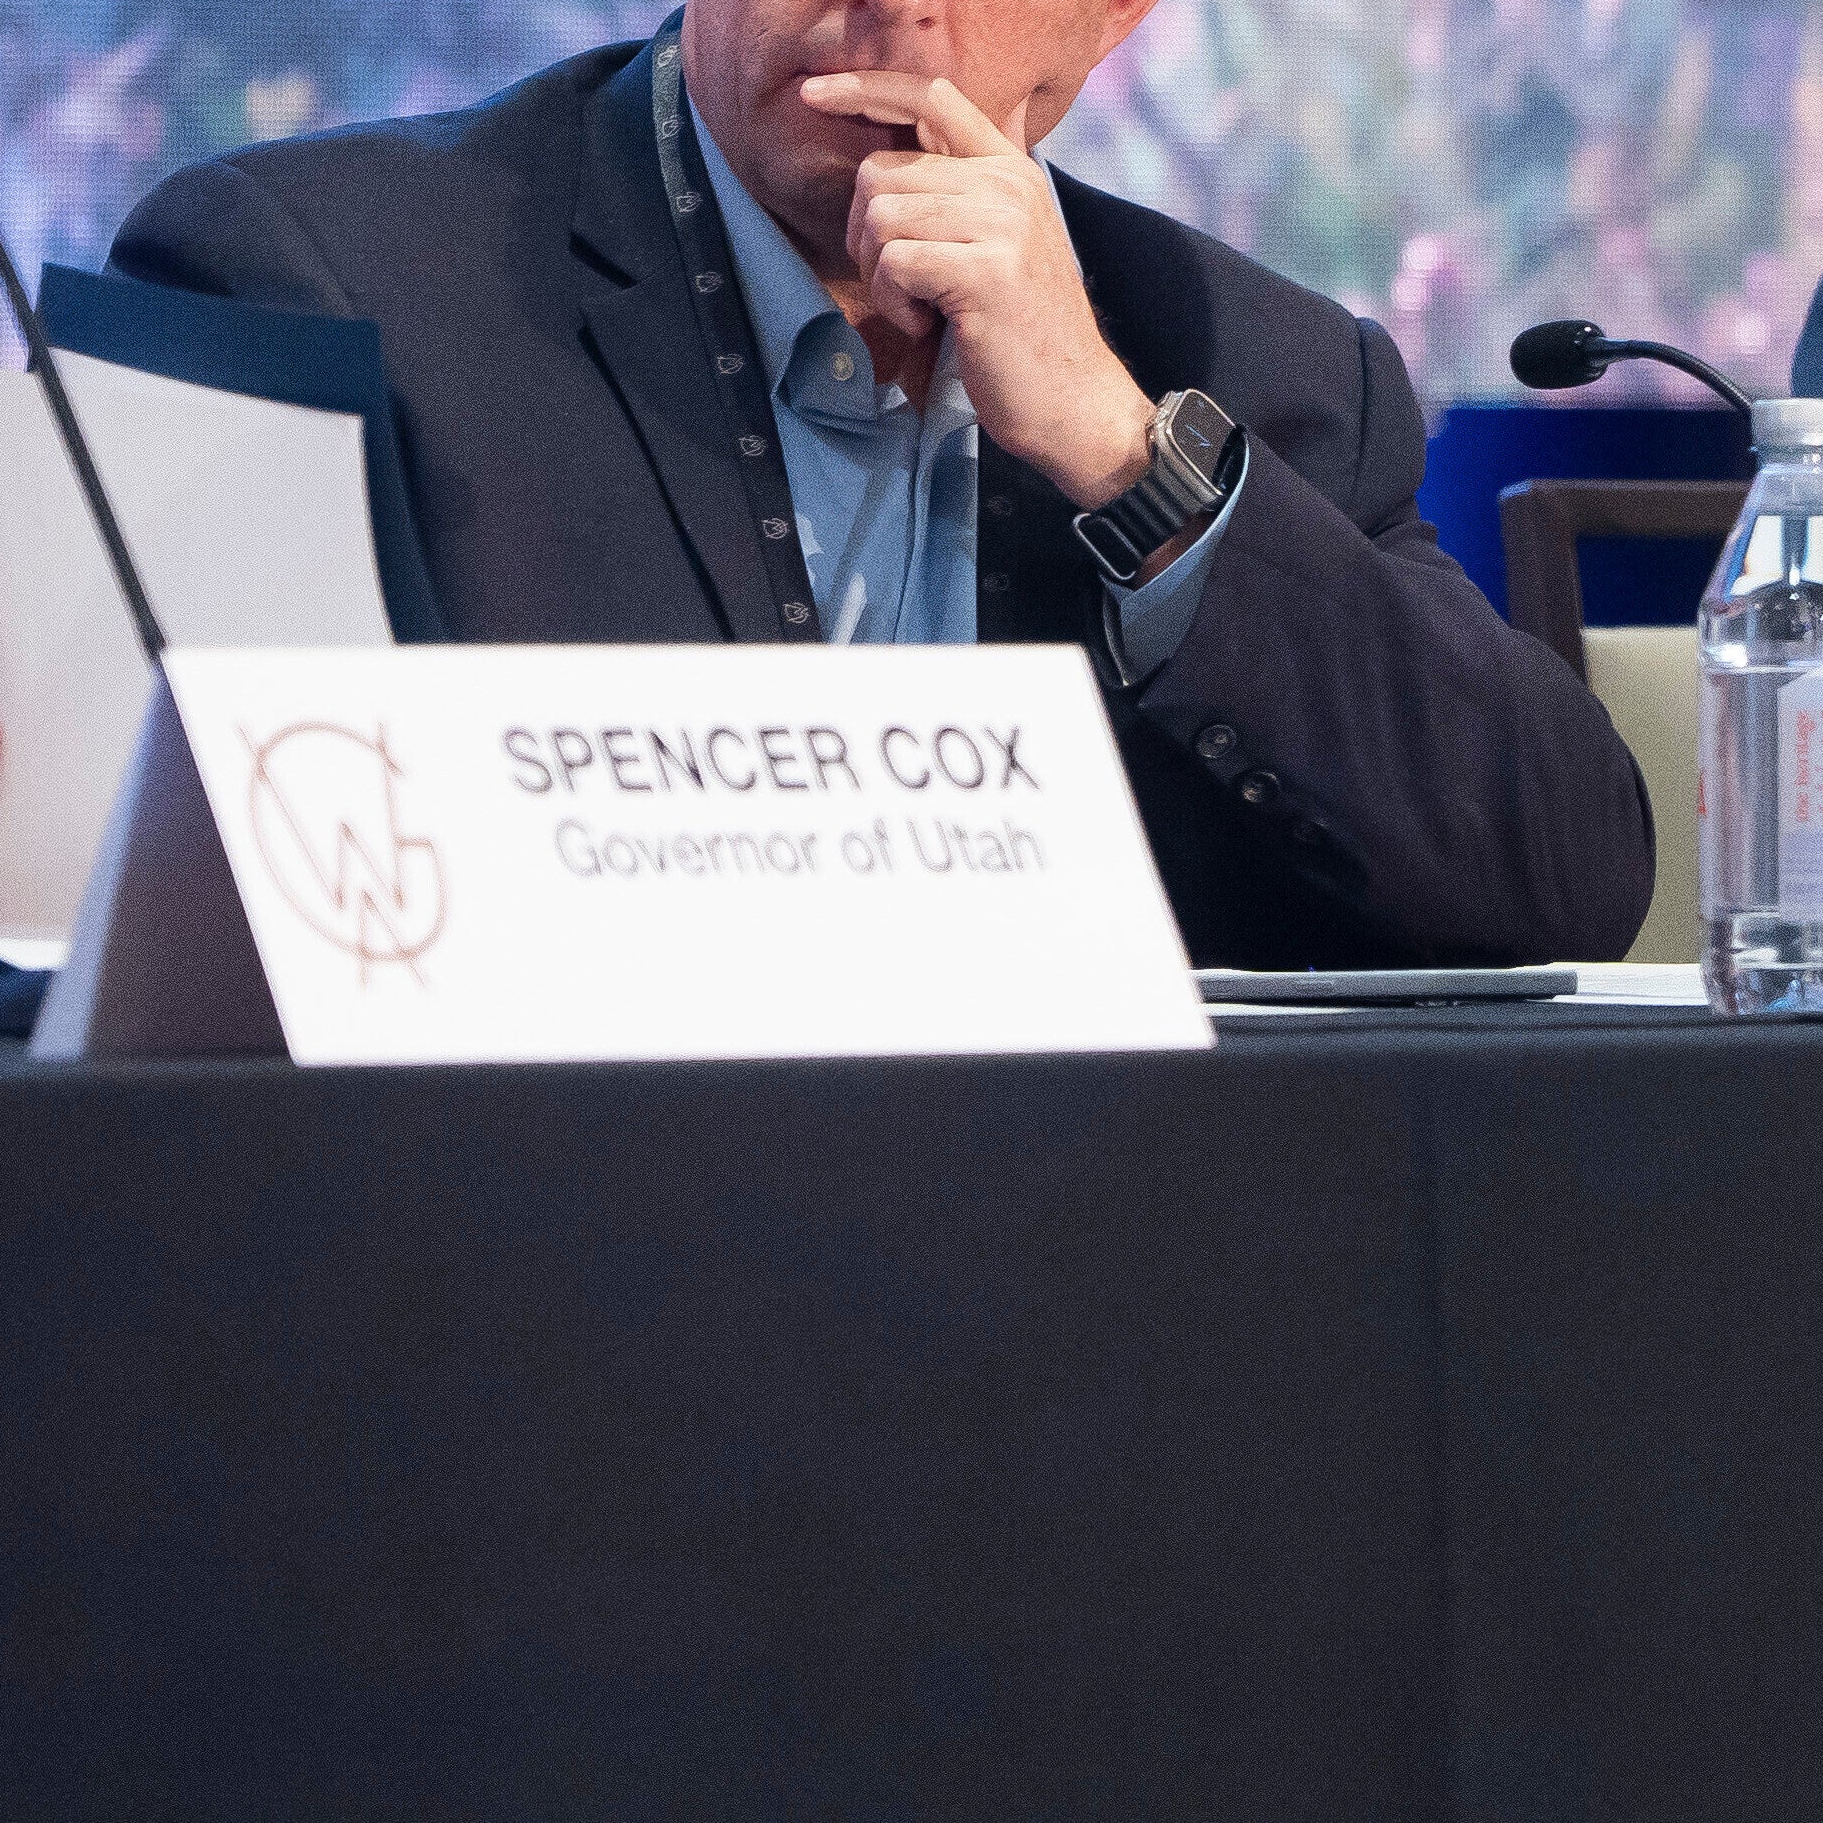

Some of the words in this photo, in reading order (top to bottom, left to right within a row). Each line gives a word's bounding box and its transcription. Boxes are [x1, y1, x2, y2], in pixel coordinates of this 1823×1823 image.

[500, 723, 862, 796] SPENCER
[876, 721, 1041, 793] COX
[553, 816, 819, 879] Governor
[839, 816, 894, 876] of
[905, 817, 1045, 875] Utah
